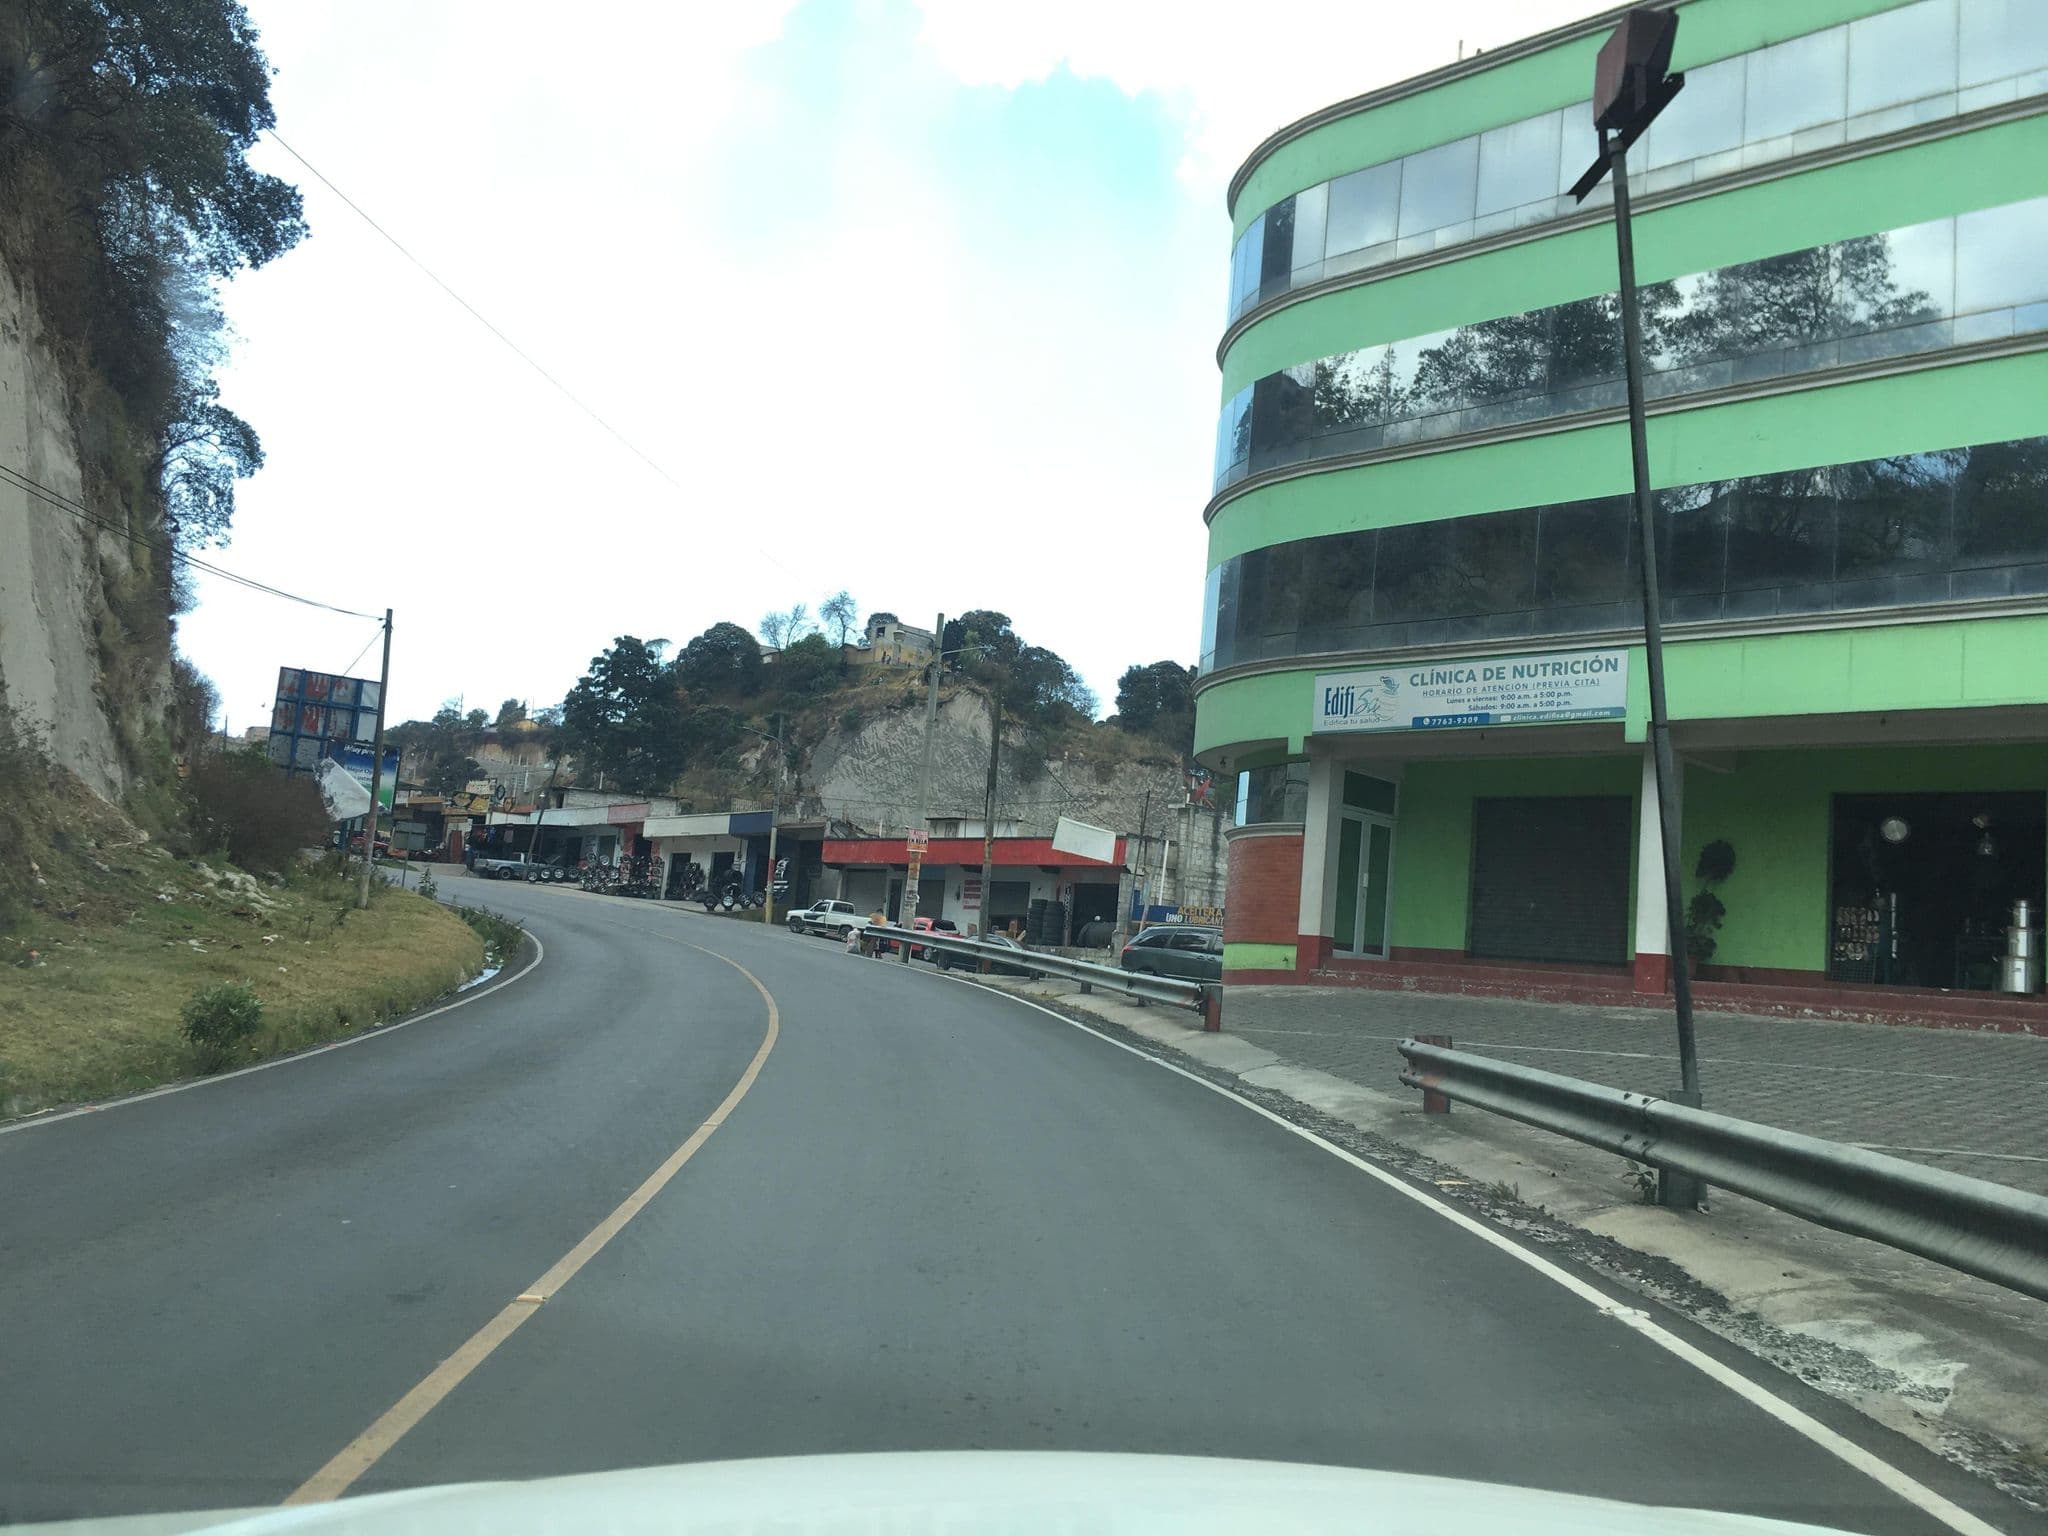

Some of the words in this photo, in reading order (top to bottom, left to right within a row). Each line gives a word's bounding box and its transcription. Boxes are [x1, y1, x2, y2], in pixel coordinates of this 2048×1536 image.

[1409, 669, 1477, 687] CLÍNICA
[1482, 666, 1506, 682] DE
[1512, 655, 1619, 679] NUTRICIÓN
[1422, 687, 1463, 697] HORARIO
[1466, 686, 1478, 694] DE
[1481, 682, 1529, 692] ATENCIÓN
[1500, 693, 1516, 701] 9:00
[1539, 690, 1556, 698] 5:00
